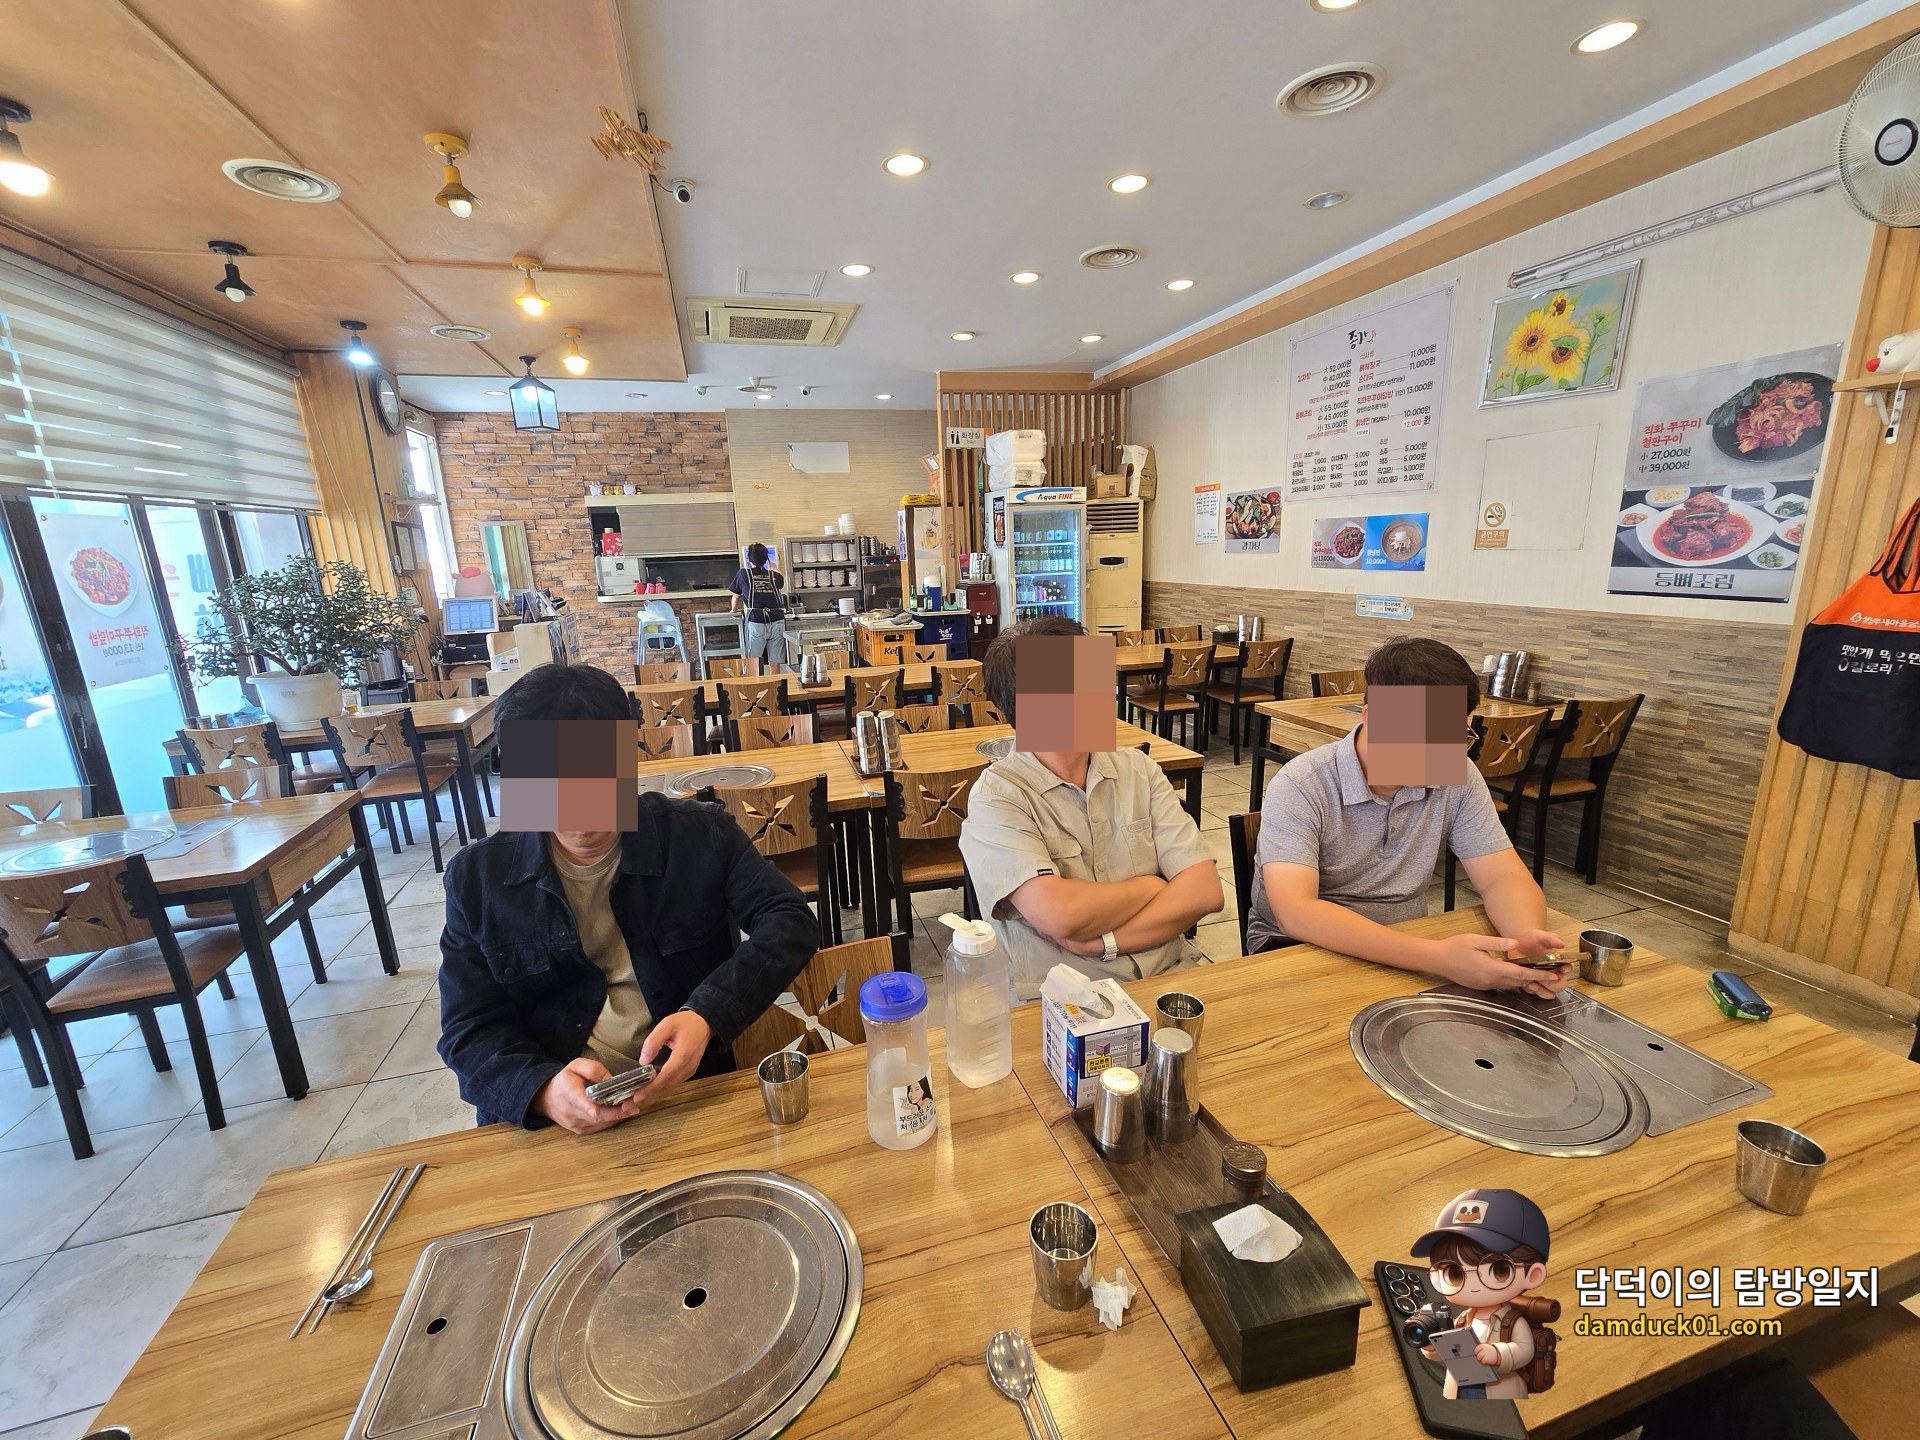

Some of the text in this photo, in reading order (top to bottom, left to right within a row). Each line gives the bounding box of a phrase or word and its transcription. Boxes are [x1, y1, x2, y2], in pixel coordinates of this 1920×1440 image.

[1644, 417, 1702, 435] 직화 쭈꾸미
[961, 431, 980, 440] 화장실
[1642, 432, 1683, 448] 철판구이
[1650, 447, 1691, 460] 27,000원
[1649, 460, 1690, 473] 39,000원
[1481, 530, 1505, 539] 금연구역
[1655, 572, 1735, 589] 등뼈조림
[1841, 644, 1874, 660] 맛있게
